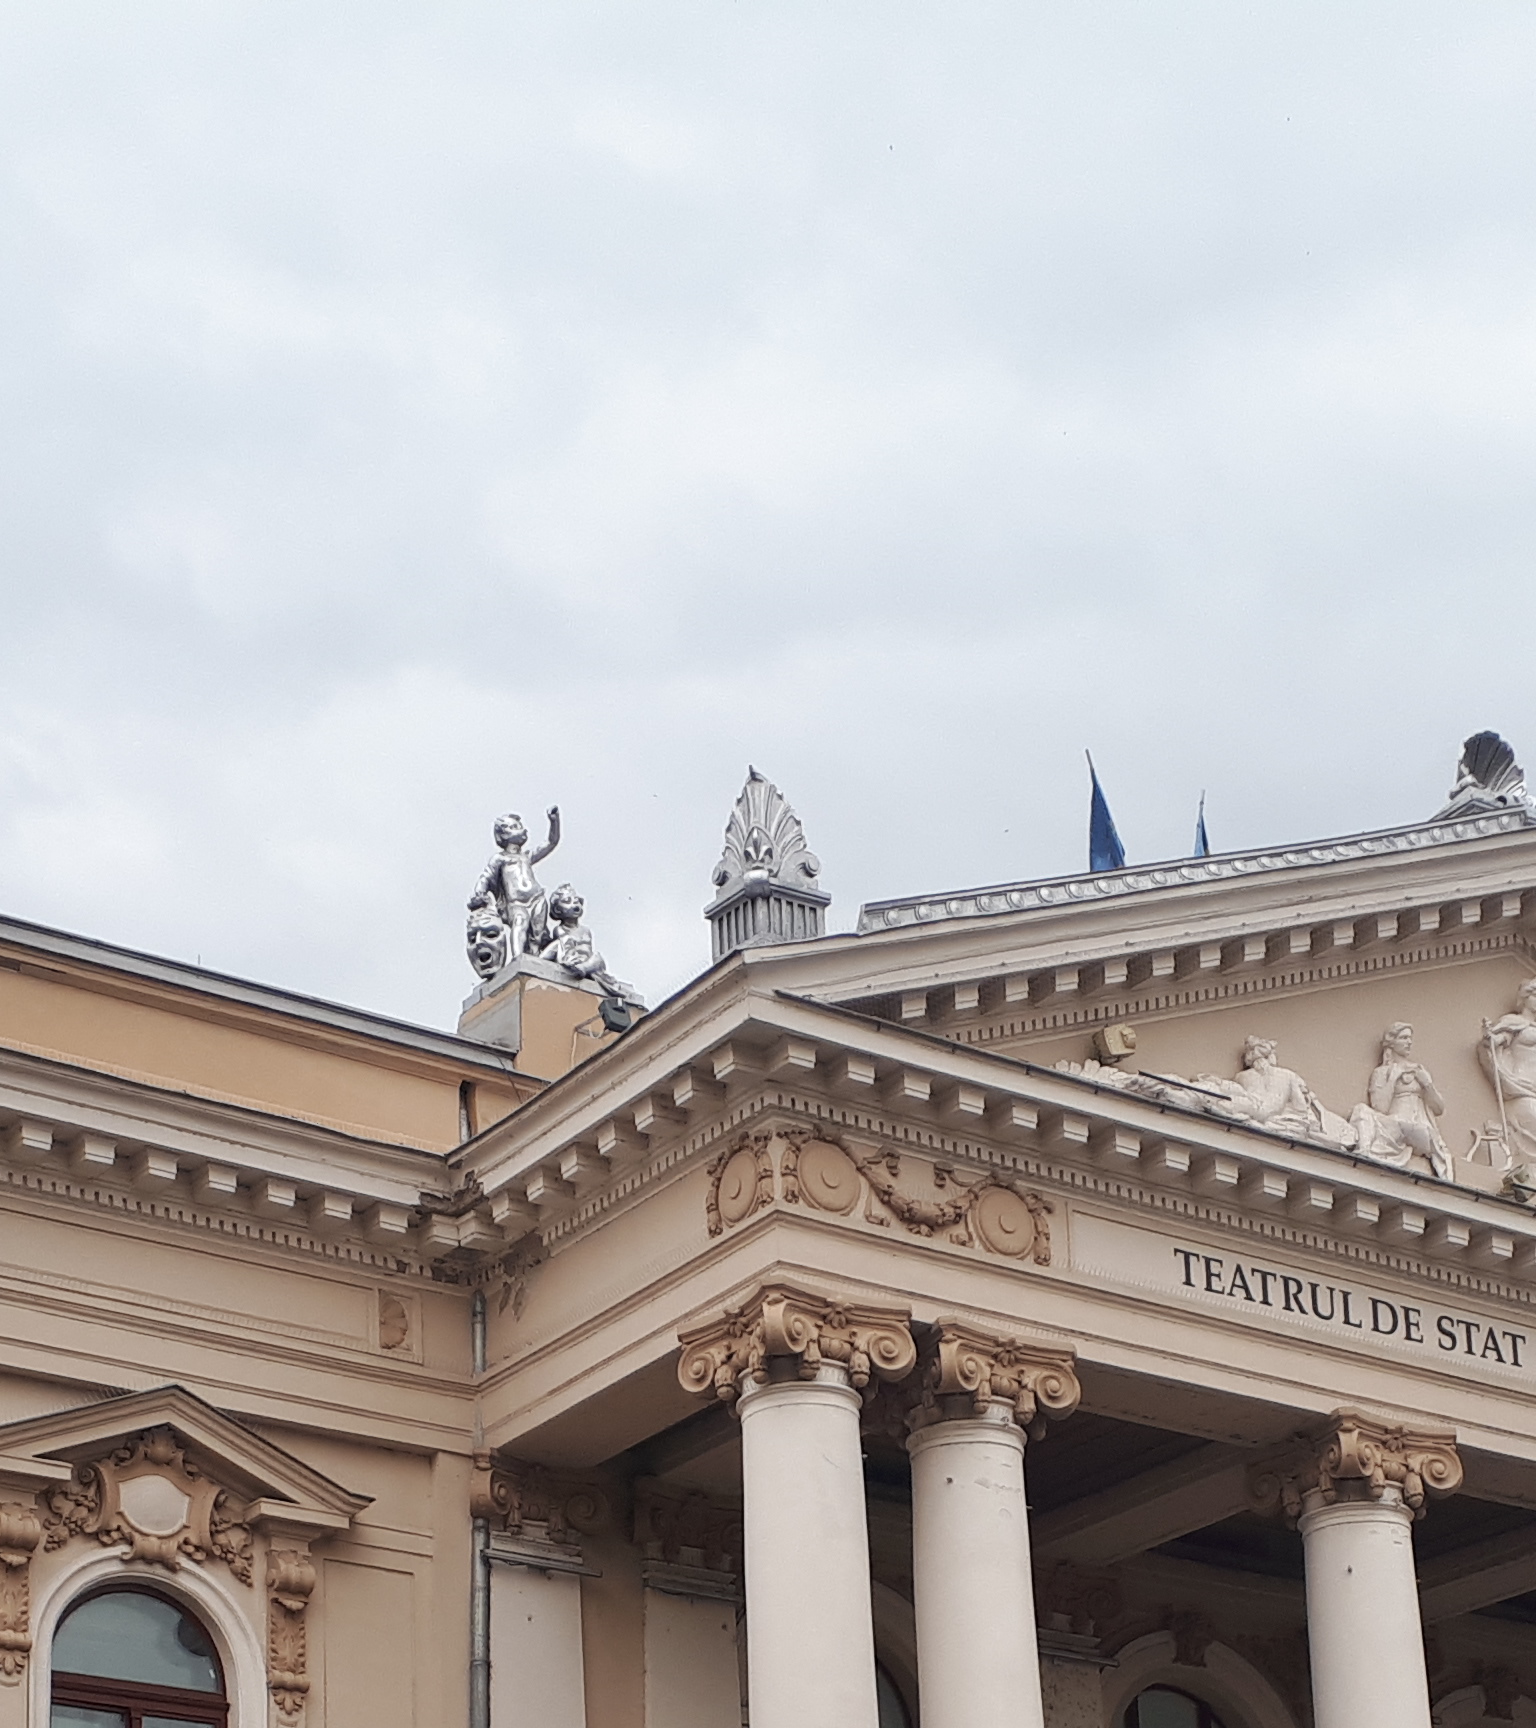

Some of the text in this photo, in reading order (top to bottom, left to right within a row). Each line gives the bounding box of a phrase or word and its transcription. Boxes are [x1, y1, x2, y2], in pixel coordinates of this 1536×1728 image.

[1173, 1247, 1363, 1329] TEATRUL
[1368, 1296, 1424, 1344] DE
[1436, 1315, 1526, 1368] STAT
